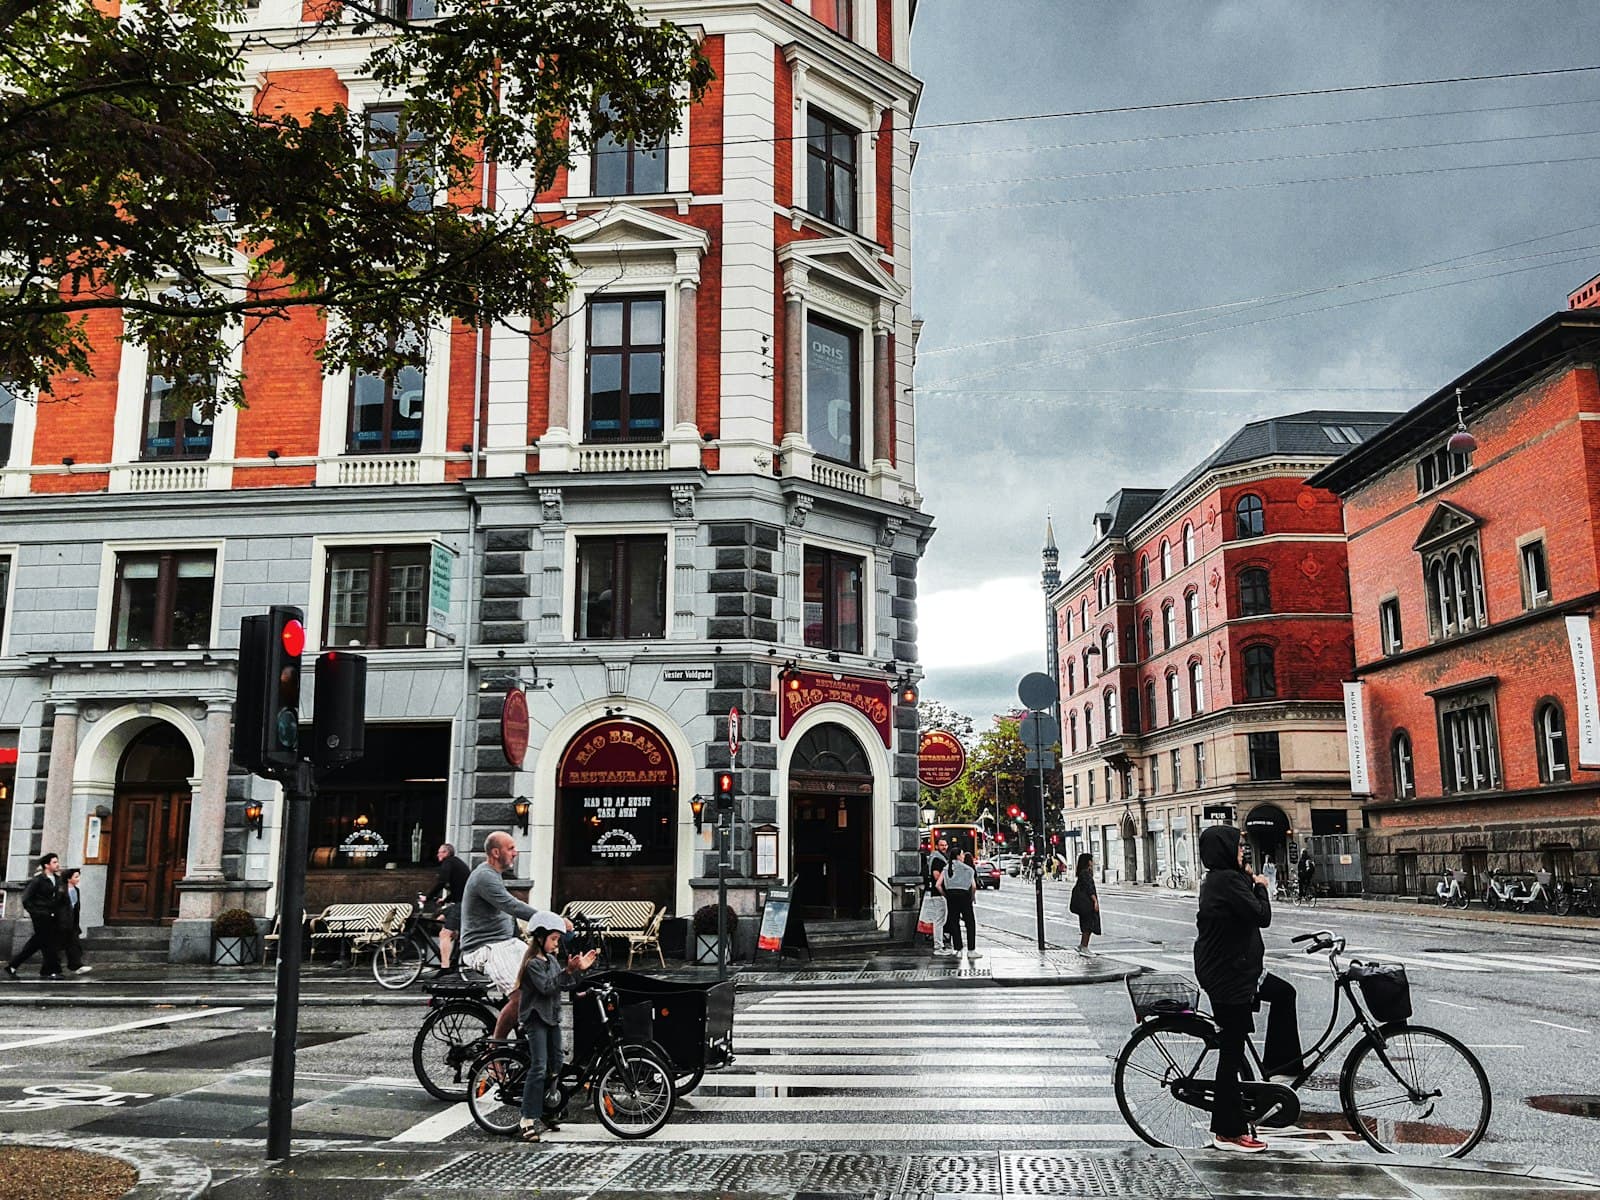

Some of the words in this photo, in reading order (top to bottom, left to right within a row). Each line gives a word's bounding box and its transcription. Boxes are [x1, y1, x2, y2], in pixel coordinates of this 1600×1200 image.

[664, 671, 684, 679] Vester
[685, 670, 711, 680] Voldgade
[815, 678, 861, 692] RESTAURANT
[1576, 636, 1588, 700] KØBENHAVNS
[1584, 704, 1592, 744] MUSEUM
[1350, 691, 1358, 721] MUSEUM
[1353, 723, 1359, 732] OF
[576, 735, 604, 765] RIO
[609, 730, 661, 765] BRAVO
[932, 736, 958, 754] BRAVO
[1354, 735, 1363, 784] COPENHAGEN
[569, 771, 667, 783] RESTAURANT
[583, 797, 600, 808] MAD
[602, 797, 613, 808] UD
[615, 796, 626, 807] AF
[627, 796, 652, 807] HUSET
[596, 807, 616, 819] TAKE
[617, 807, 637, 818] AWAY
